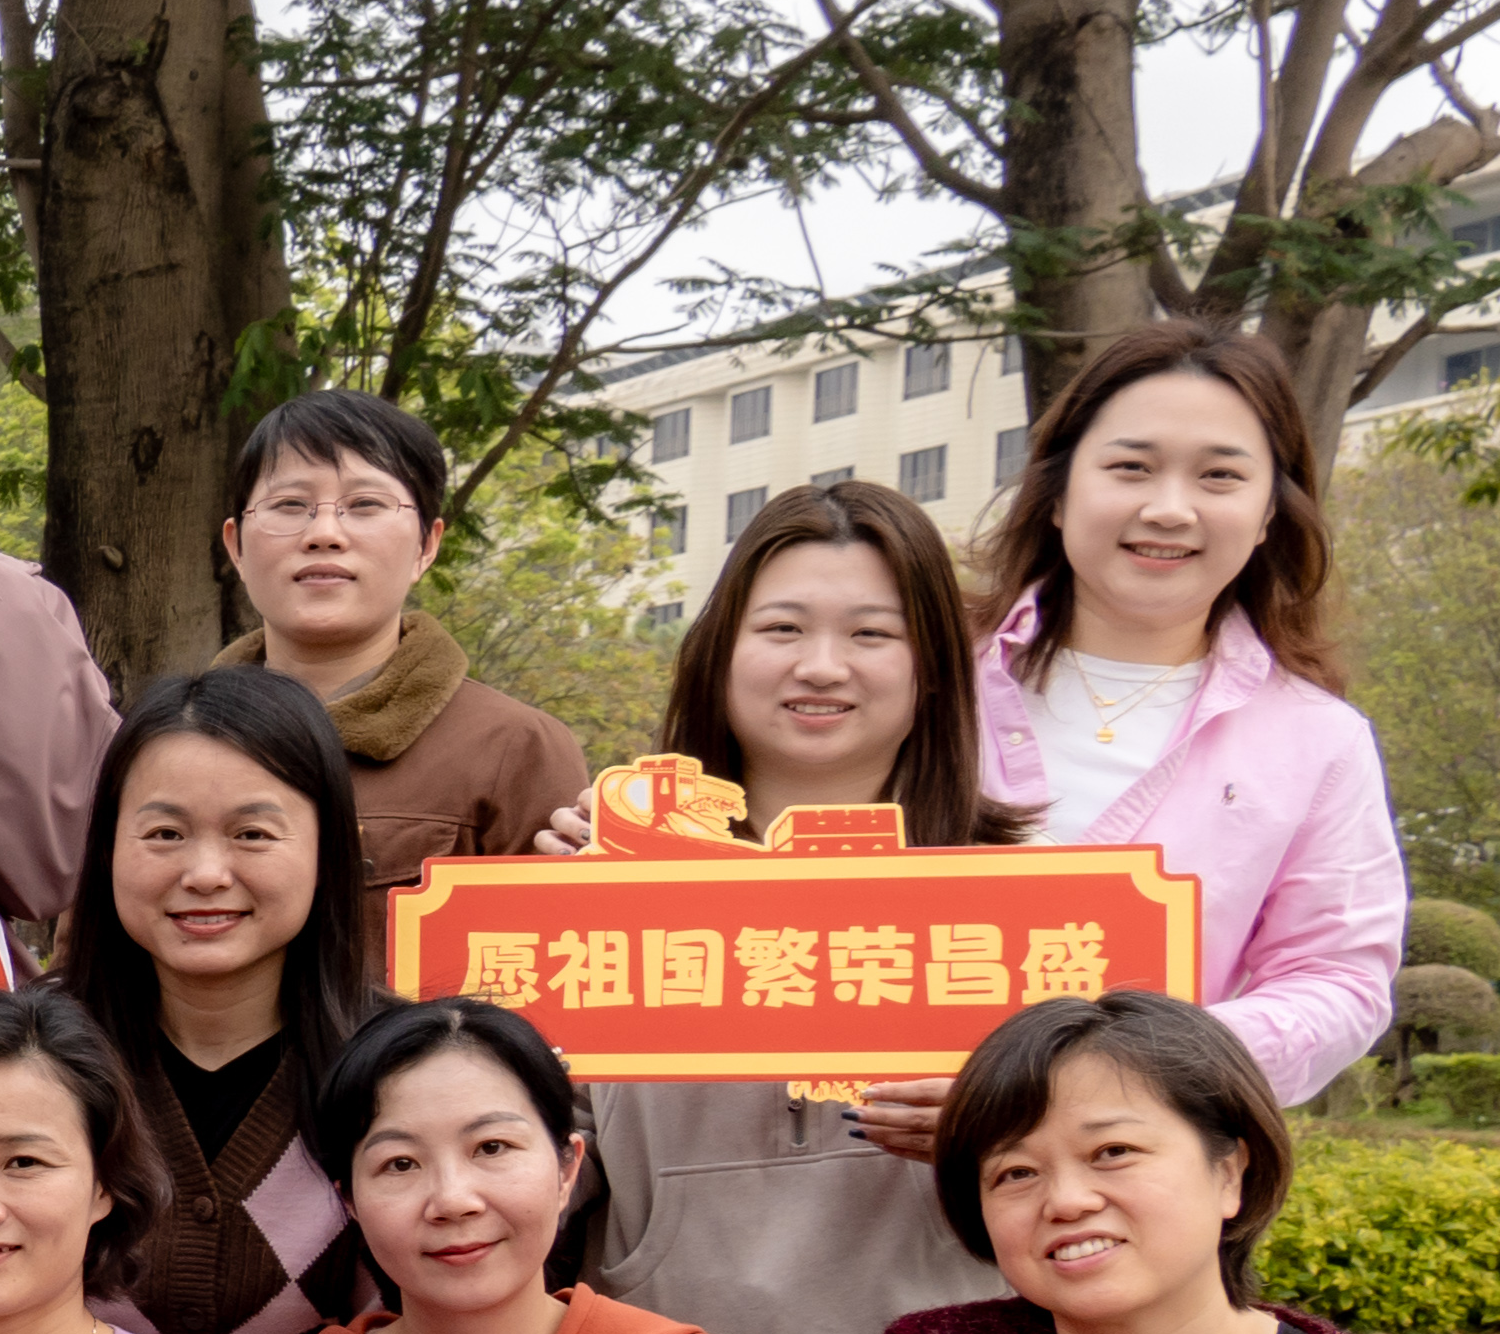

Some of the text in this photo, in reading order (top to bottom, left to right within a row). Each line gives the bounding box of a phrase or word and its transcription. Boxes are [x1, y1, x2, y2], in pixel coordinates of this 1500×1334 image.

[466, 921, 1111, 1010] 愿祖国繁荣昌盛
